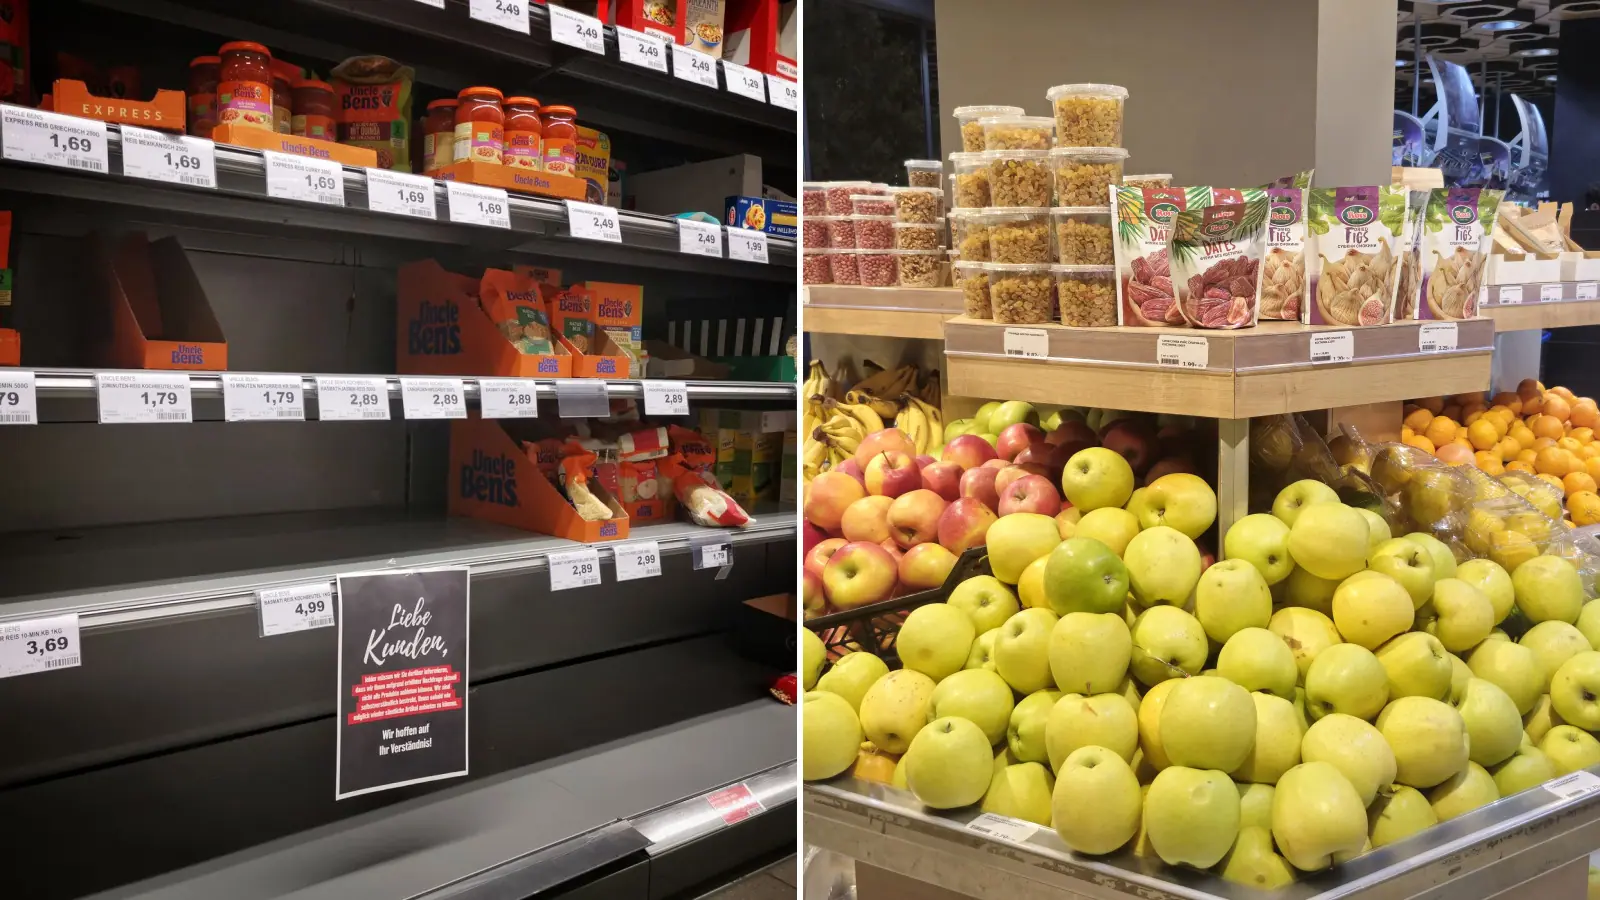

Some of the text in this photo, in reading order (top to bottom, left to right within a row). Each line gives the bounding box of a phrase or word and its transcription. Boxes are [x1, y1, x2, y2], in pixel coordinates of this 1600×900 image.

[496, 0, 520, 16] 2,49
[576, 24, 598, 40] 2,49
[638, 43, 658, 57] 2,49
[692, 58, 710, 72] 2,49
[742, 76, 759, 89] 1,29
[350, 86, 378, 95] Uncle
[342, 94, 379, 110] Bens
[82, 103, 162, 121] EXPRESS
[5, 117, 34, 126] EXPRESS
[50, 124, 86, 135] GRIECHISCH
[50, 134, 92, 152] 1,69
[281, 140, 330, 159] Uncle Bens
[164, 152, 200, 170] 1,69
[305, 174, 336, 190] 1,69
[514, 173, 550, 188] Uncle Bens
[398, 189, 424, 203] 1,69
[478, 201, 502, 214] 1,69
[593, 218, 614, 229] 2,49
[698, 234, 716, 244] 2,49
[1269, 227, 1291, 242] FIGS
[1344, 227, 1369, 244] FIGS
[1455, 225, 1472, 241] FIGS
[746, 241, 762, 252] 1,99
[1202, 238, 1236, 256] DATES
[506, 290, 534, 302] Bens
[604, 298, 623, 308] Uncle
[419, 299, 458, 325] Uncle
[559, 299, 583, 312] Bens
[598, 304, 623, 318] Bens
[408, 324, 462, 356] Bens
[178, 344, 202, 354] Uncle
[172, 351, 203, 364] Bens
[538, 362, 558, 372] Bens
[597, 362, 616, 373] Bens
[141, 392, 178, 408] 1,79
[263, 391, 294, 406] 1,79
[350, 394, 378, 407] 2,89
[433, 394, 458, 407] 2,89
[509, 394, 531, 406] 2,89
[665, 394, 683, 405] 2,89
[472, 450, 515, 480] Uncle
[460, 468, 519, 507] Bens
[637, 554, 655, 566] 2,99
[572, 564, 593, 577] 2,89
[295, 600, 325, 616] 4,99
[388, 597, 432, 630] Liebe
[26, 636, 68, 656] 3,69
[364, 627, 448, 666] Kunden,
[361, 699, 399, 710] selbstverständlich
[382, 723, 430, 741] Wir hoffen auf
[379, 737, 432, 756] Ihr Verständnis!
